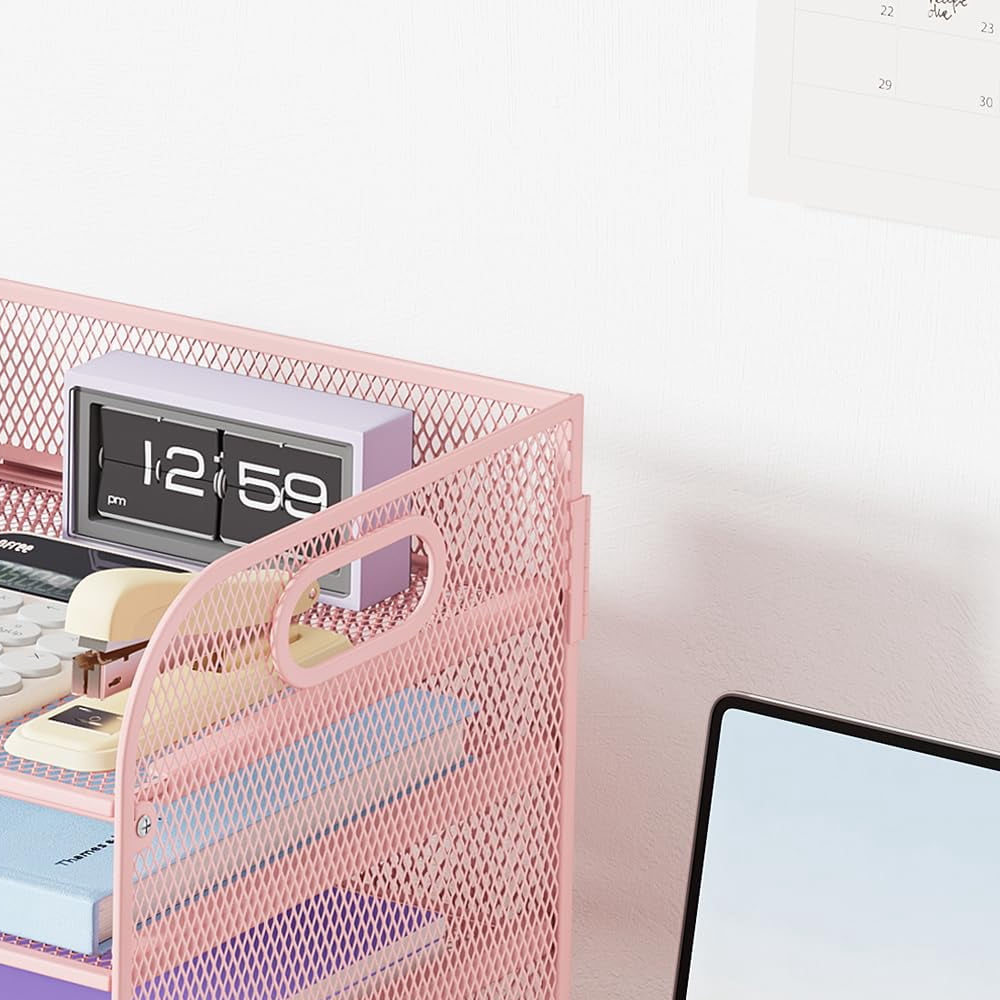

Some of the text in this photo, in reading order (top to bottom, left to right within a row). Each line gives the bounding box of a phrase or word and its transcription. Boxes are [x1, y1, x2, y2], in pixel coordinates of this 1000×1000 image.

[880, 5, 895, 17] 22
[980, 21, 994, 34] 23
[878, 78, 893, 91] 29
[979, 95, 994, 108] 30
[143, 440, 328, 519] 12 59
[107, 494, 127, 507] pm
[54, 843, 107, 866] Thames
